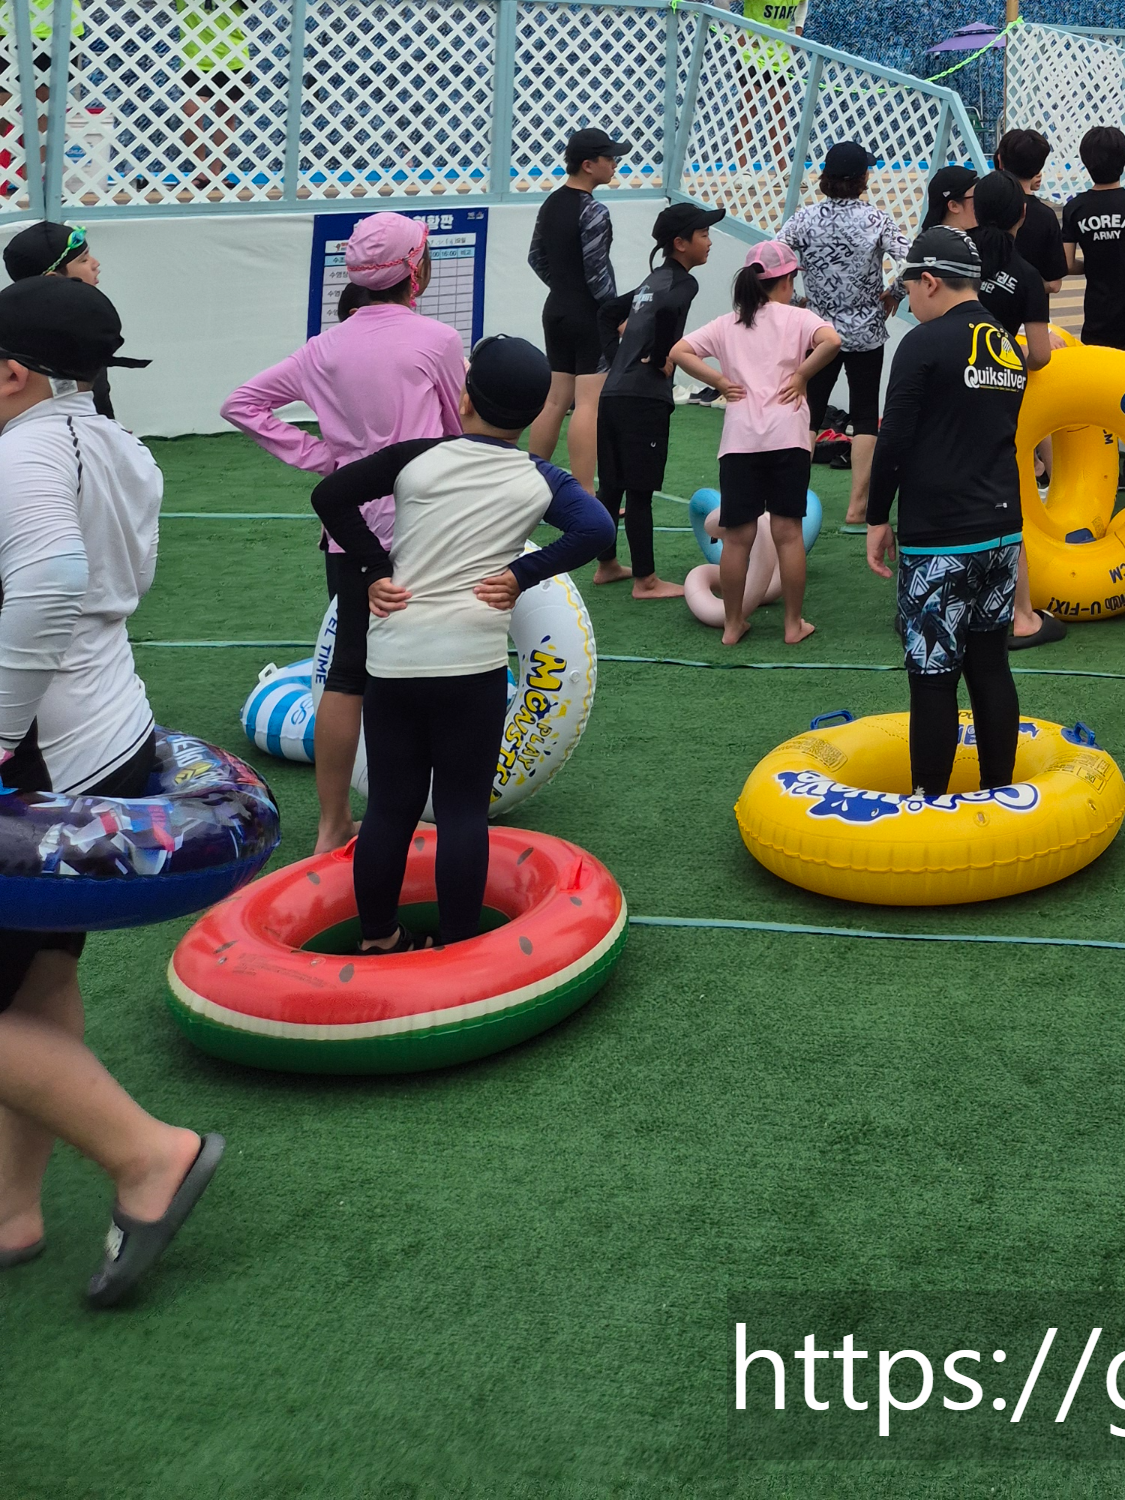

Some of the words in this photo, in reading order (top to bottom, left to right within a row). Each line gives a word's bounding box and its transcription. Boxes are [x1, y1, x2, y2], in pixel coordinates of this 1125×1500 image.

[1092, 230, 1122, 242] ARMY
[995, 270, 1019, 291] 권도
[963, 365, 1027, 390] Quiksilver
[1047, 596, 1102, 617] U-FIX!
[315, 644, 333, 685] TIME
[517, 721, 553, 771] PLAY
